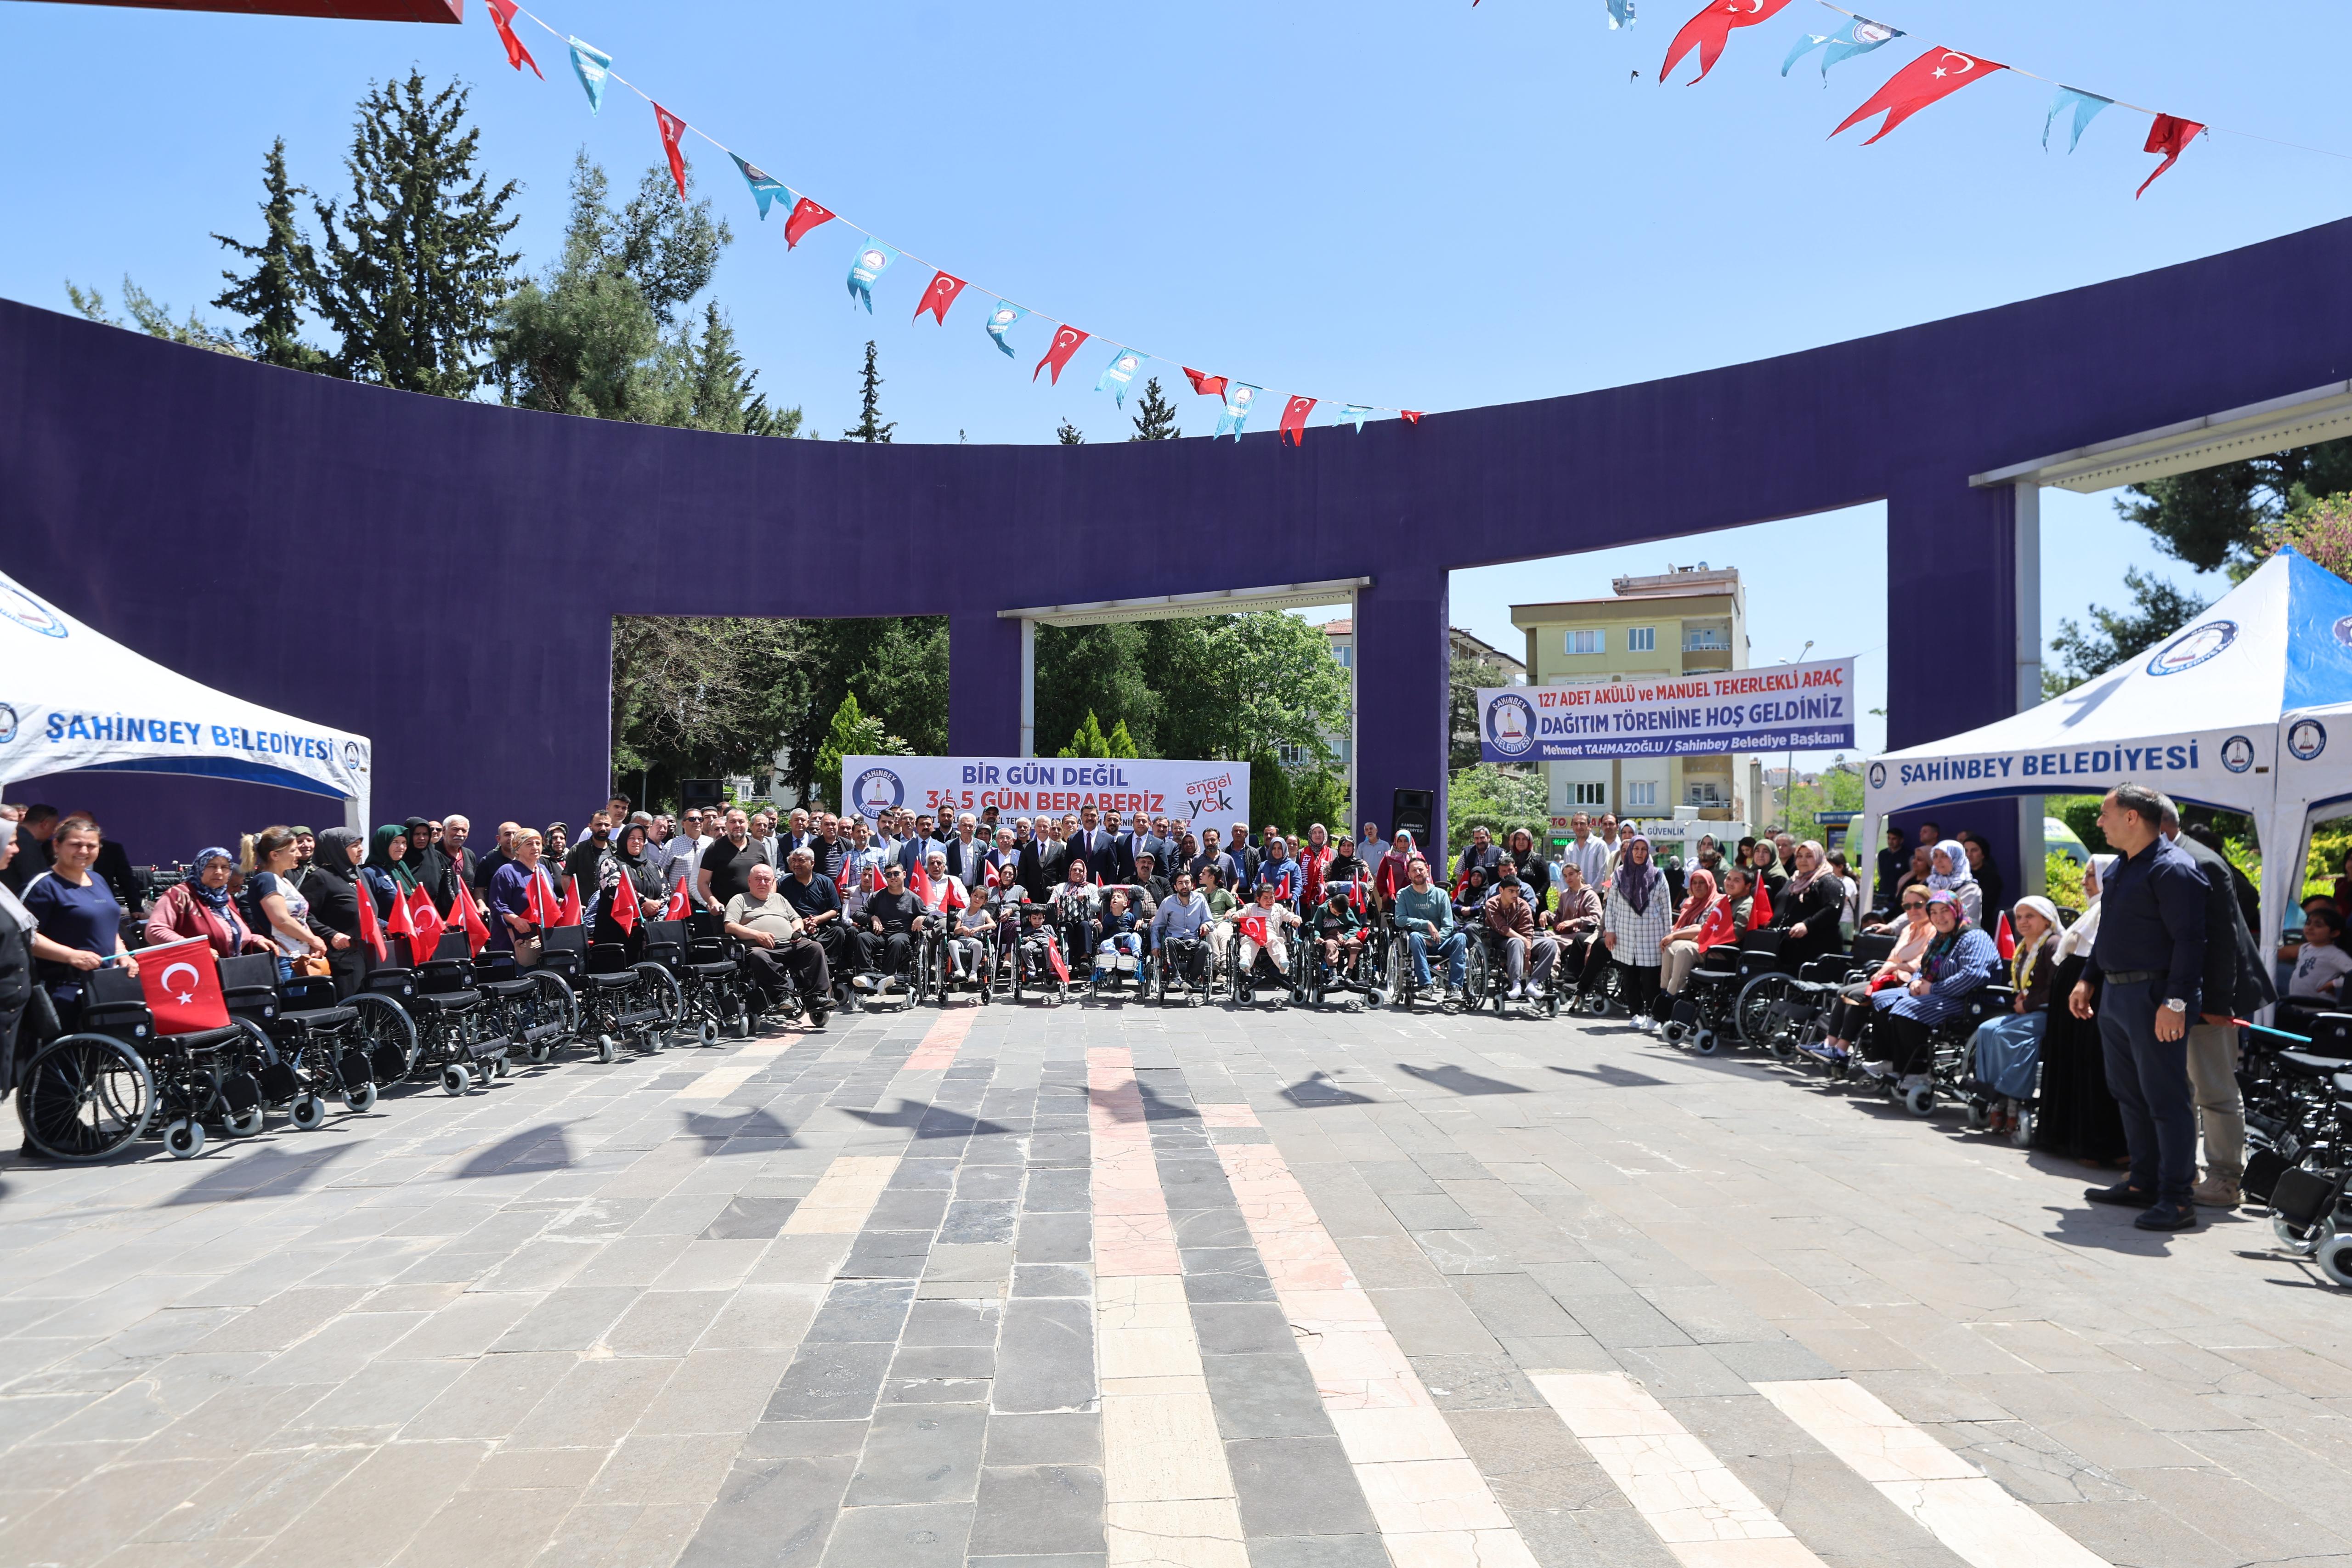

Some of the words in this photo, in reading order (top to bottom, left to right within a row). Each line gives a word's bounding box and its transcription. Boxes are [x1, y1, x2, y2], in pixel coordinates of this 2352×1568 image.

[1538, 692, 1556, 707] 127
[1560, 690, 1590, 706] ADET
[1594, 685, 1635, 704] AKÜLÜ
[1640, 689, 1653, 701] ve
[1656, 682, 1710, 700] MANUEL
[1714, 670, 1798, 696] TEKERLEKLİ
[1803, 667, 1843, 689] ARAÇ
[1541, 713, 1609, 734] DAĞITIM
[1613, 705, 1702, 730] TÖRENİNE
[1706, 706, 1744, 728] HOŞ
[1749, 693, 1843, 722] GELDİNİZ
[46, 712, 201, 745] ŞAHİNBEY
[211, 724, 334, 762] BELEDİYESİ
[1543, 744, 1583, 757] Mehmet
[1585, 738, 1663, 755] TAHMAZOĞLU
[1675, 737, 1728, 755] Şahinbey
[1731, 735, 1787, 752] Belediye
[1790, 731, 1844, 747] Başkanı
[962, 761, 1000, 785] BİR
[1006, 762, 1055, 785] GÜN
[1063, 764, 1128, 787] DEĞİL
[1900, 755, 2013, 785] ŞAHİNBEY
[2023, 739, 2198, 776] BELEDİYESİ
[1187, 772, 1232, 795] engel
[981, 787, 1029, 810] GÜN
[1037, 789, 1165, 812] BERABERİZ
[1647, 826, 1685, 836] GÜVENLİK
